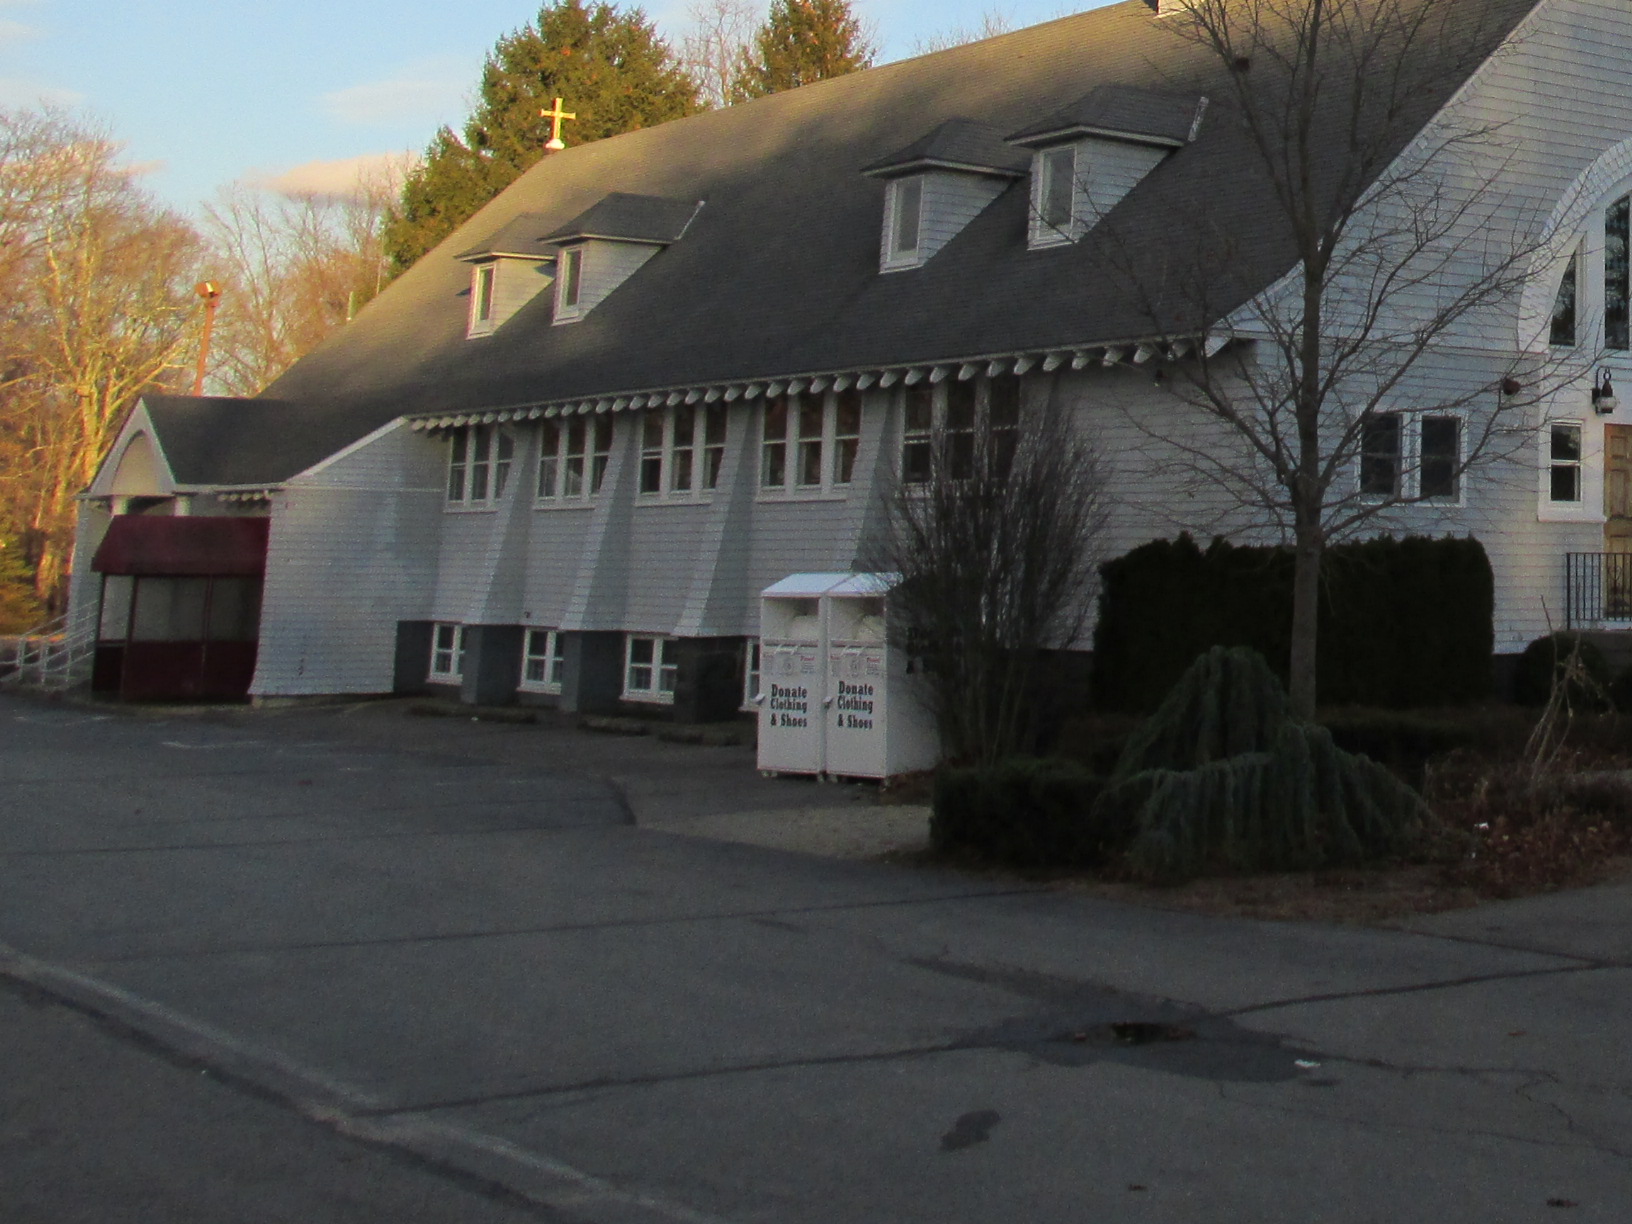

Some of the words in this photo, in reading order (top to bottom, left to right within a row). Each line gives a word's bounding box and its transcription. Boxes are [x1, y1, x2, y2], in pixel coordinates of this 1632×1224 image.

[771, 684, 807, 698] Donate
[839, 681, 873, 695] Donate
[770, 698, 807, 713] Clothing
[838, 696, 873, 714] Clothing
[771, 713, 777, 726] &
[781, 714, 807, 727] Shoes
[838, 714, 843, 727] &
[848, 715, 873, 729] Shoes
